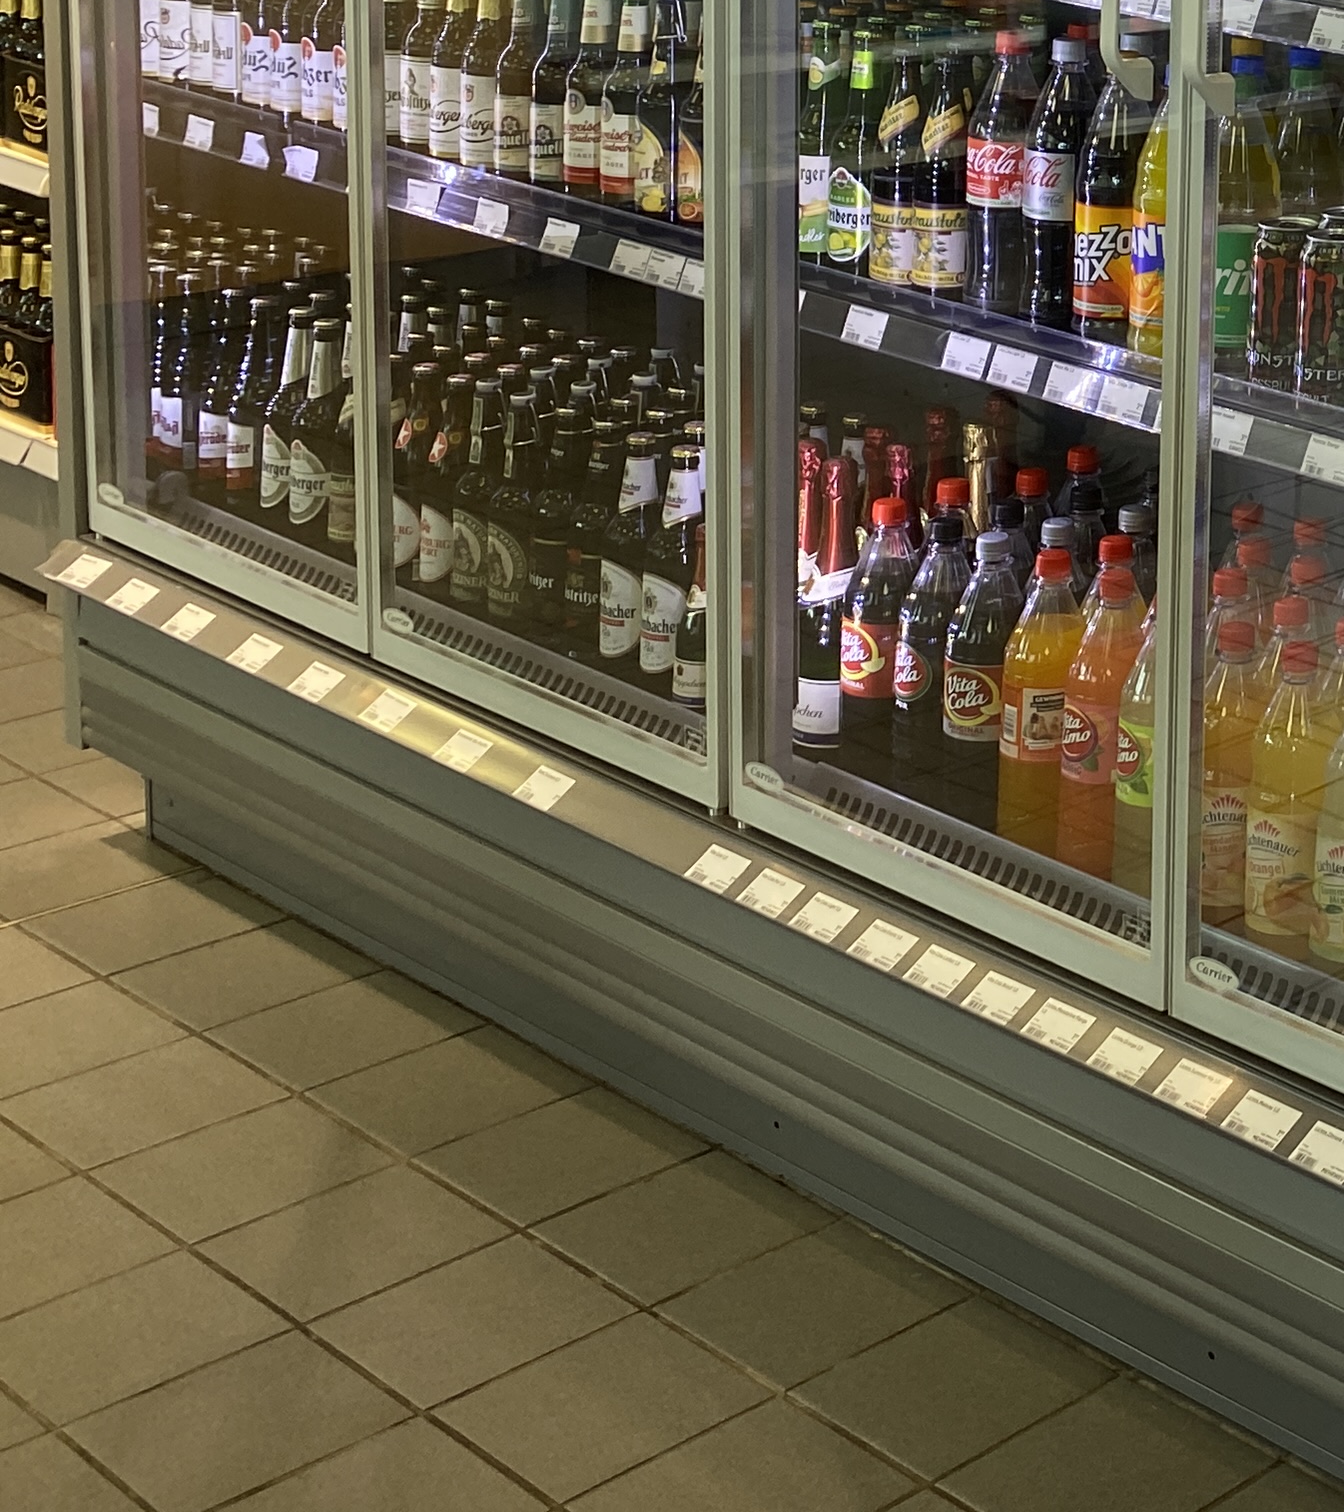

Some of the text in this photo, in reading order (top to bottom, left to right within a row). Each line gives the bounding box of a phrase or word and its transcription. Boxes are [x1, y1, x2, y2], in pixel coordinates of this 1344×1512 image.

[948, 675, 978, 696] Vita
[948, 691, 986, 711] Cola
[1197, 961, 1234, 984] Carrier
